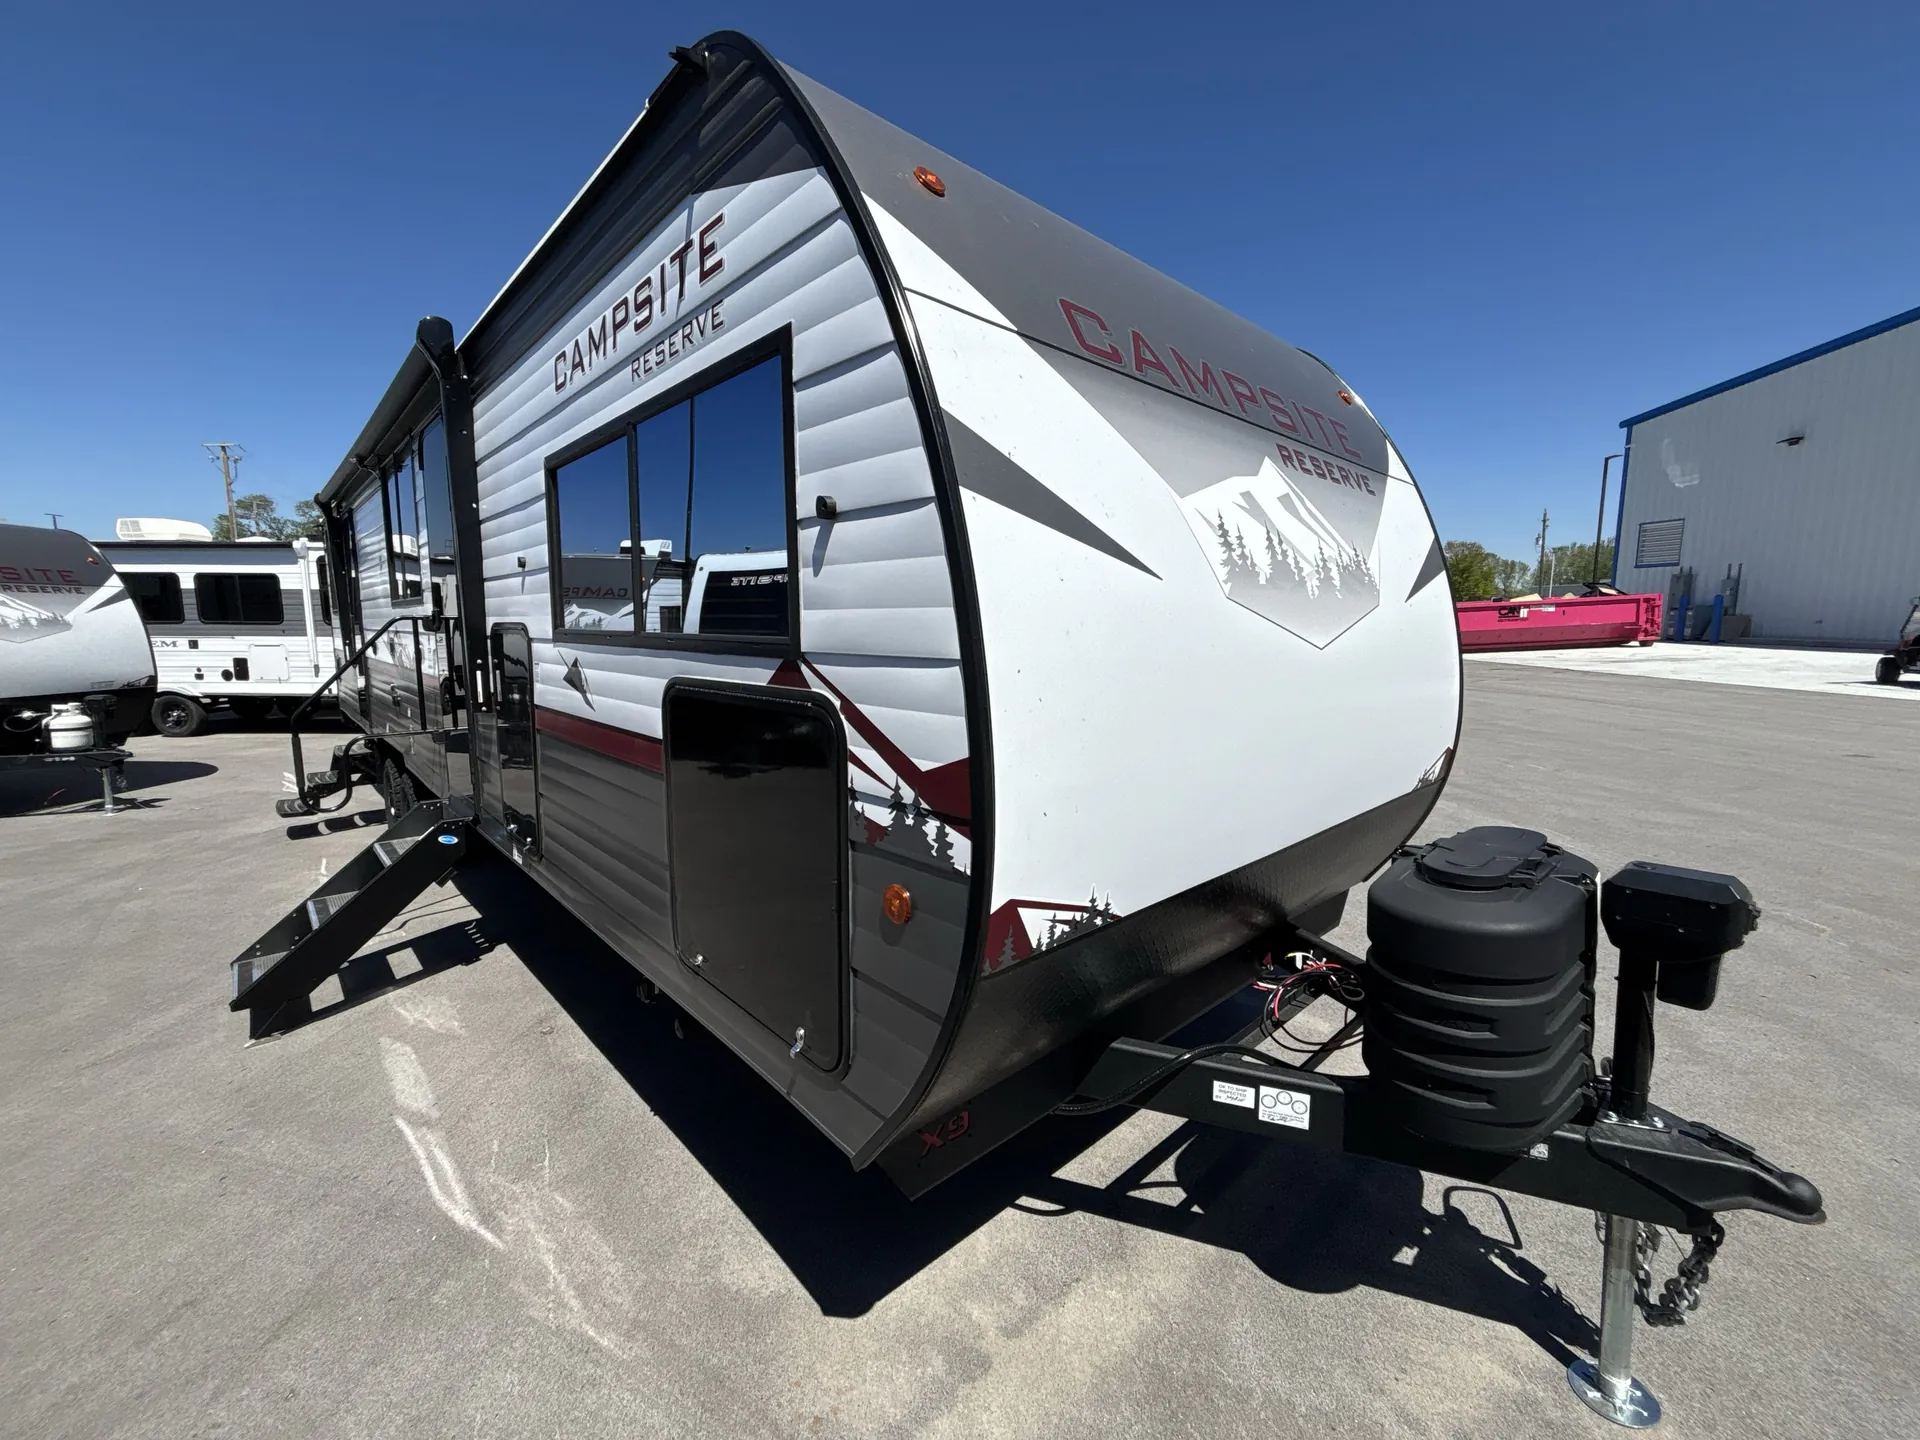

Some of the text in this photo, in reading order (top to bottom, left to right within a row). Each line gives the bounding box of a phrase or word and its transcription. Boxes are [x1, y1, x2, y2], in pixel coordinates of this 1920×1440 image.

[554, 211, 725, 393] CAMPSITE
[630, 301, 725, 384] RESERVE
[1057, 297, 1363, 459] CAMPSITE
[1275, 442, 1377, 496] RESERVE
[0, 566, 82, 586] SITE
[0, 584, 86, 595] RESERVE
